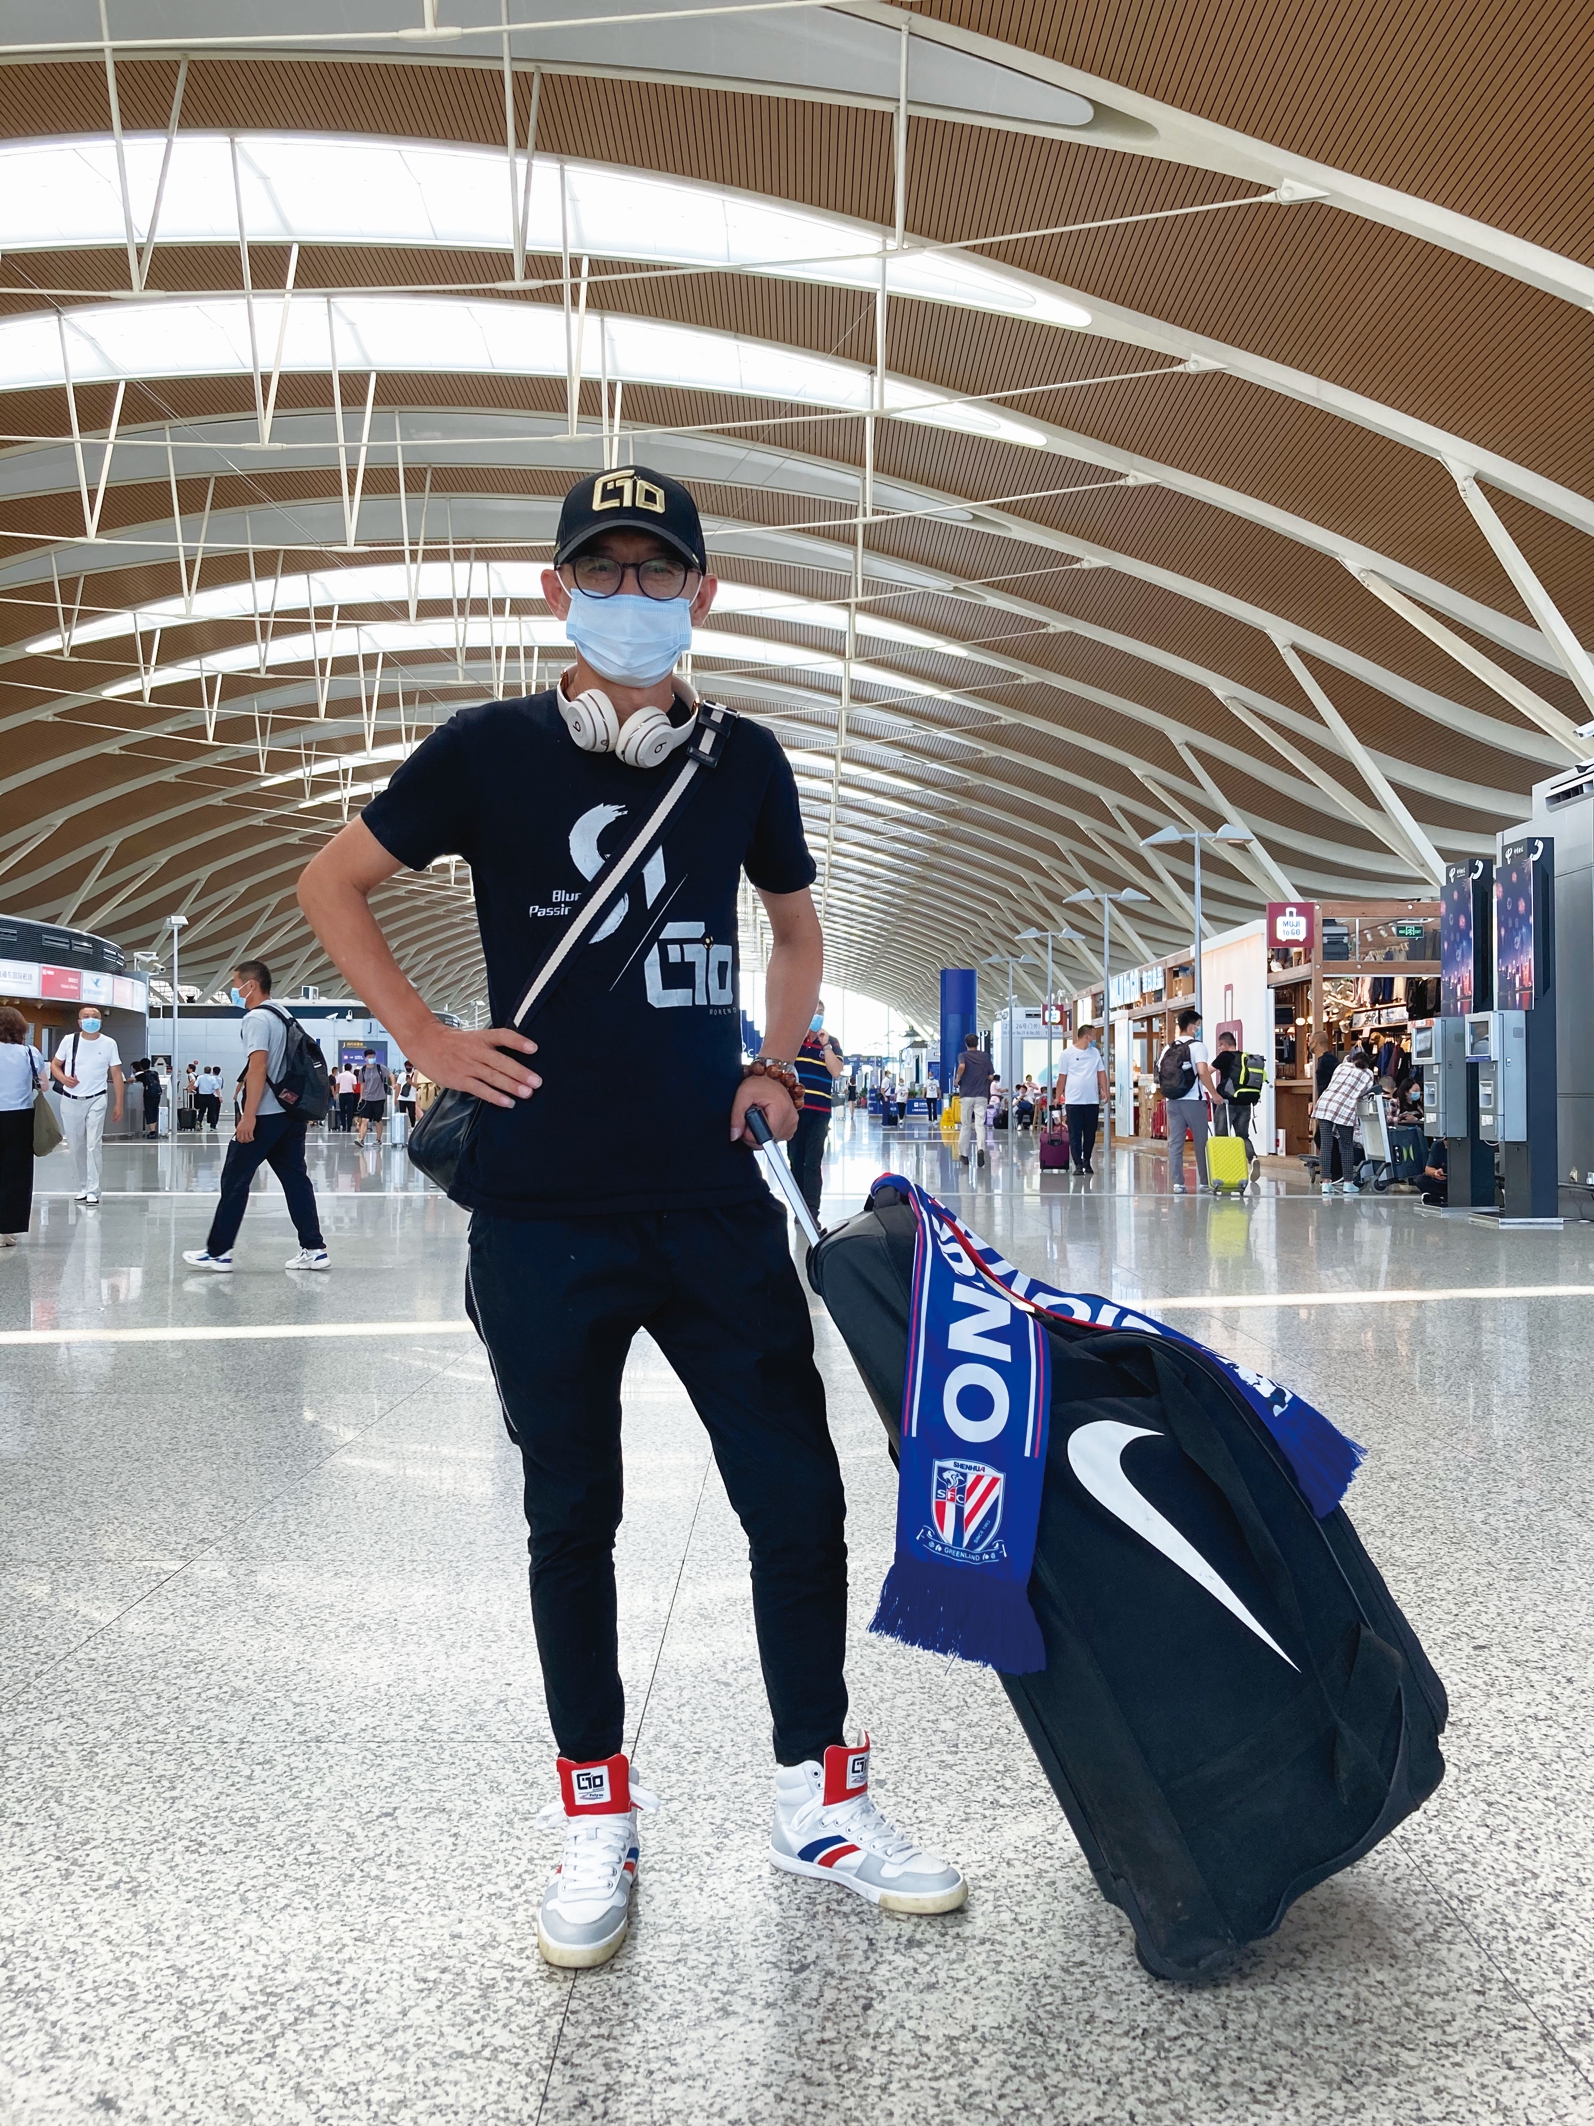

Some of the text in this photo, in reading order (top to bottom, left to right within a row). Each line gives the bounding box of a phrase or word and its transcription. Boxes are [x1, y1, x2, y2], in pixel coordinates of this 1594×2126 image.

[1282, 920, 1301, 928] MUJI
[953, 1461, 986, 1473] SHENHUA
[937, 1489, 965, 1504] SFC
[944, 1546, 980, 1561] GREENLAND
